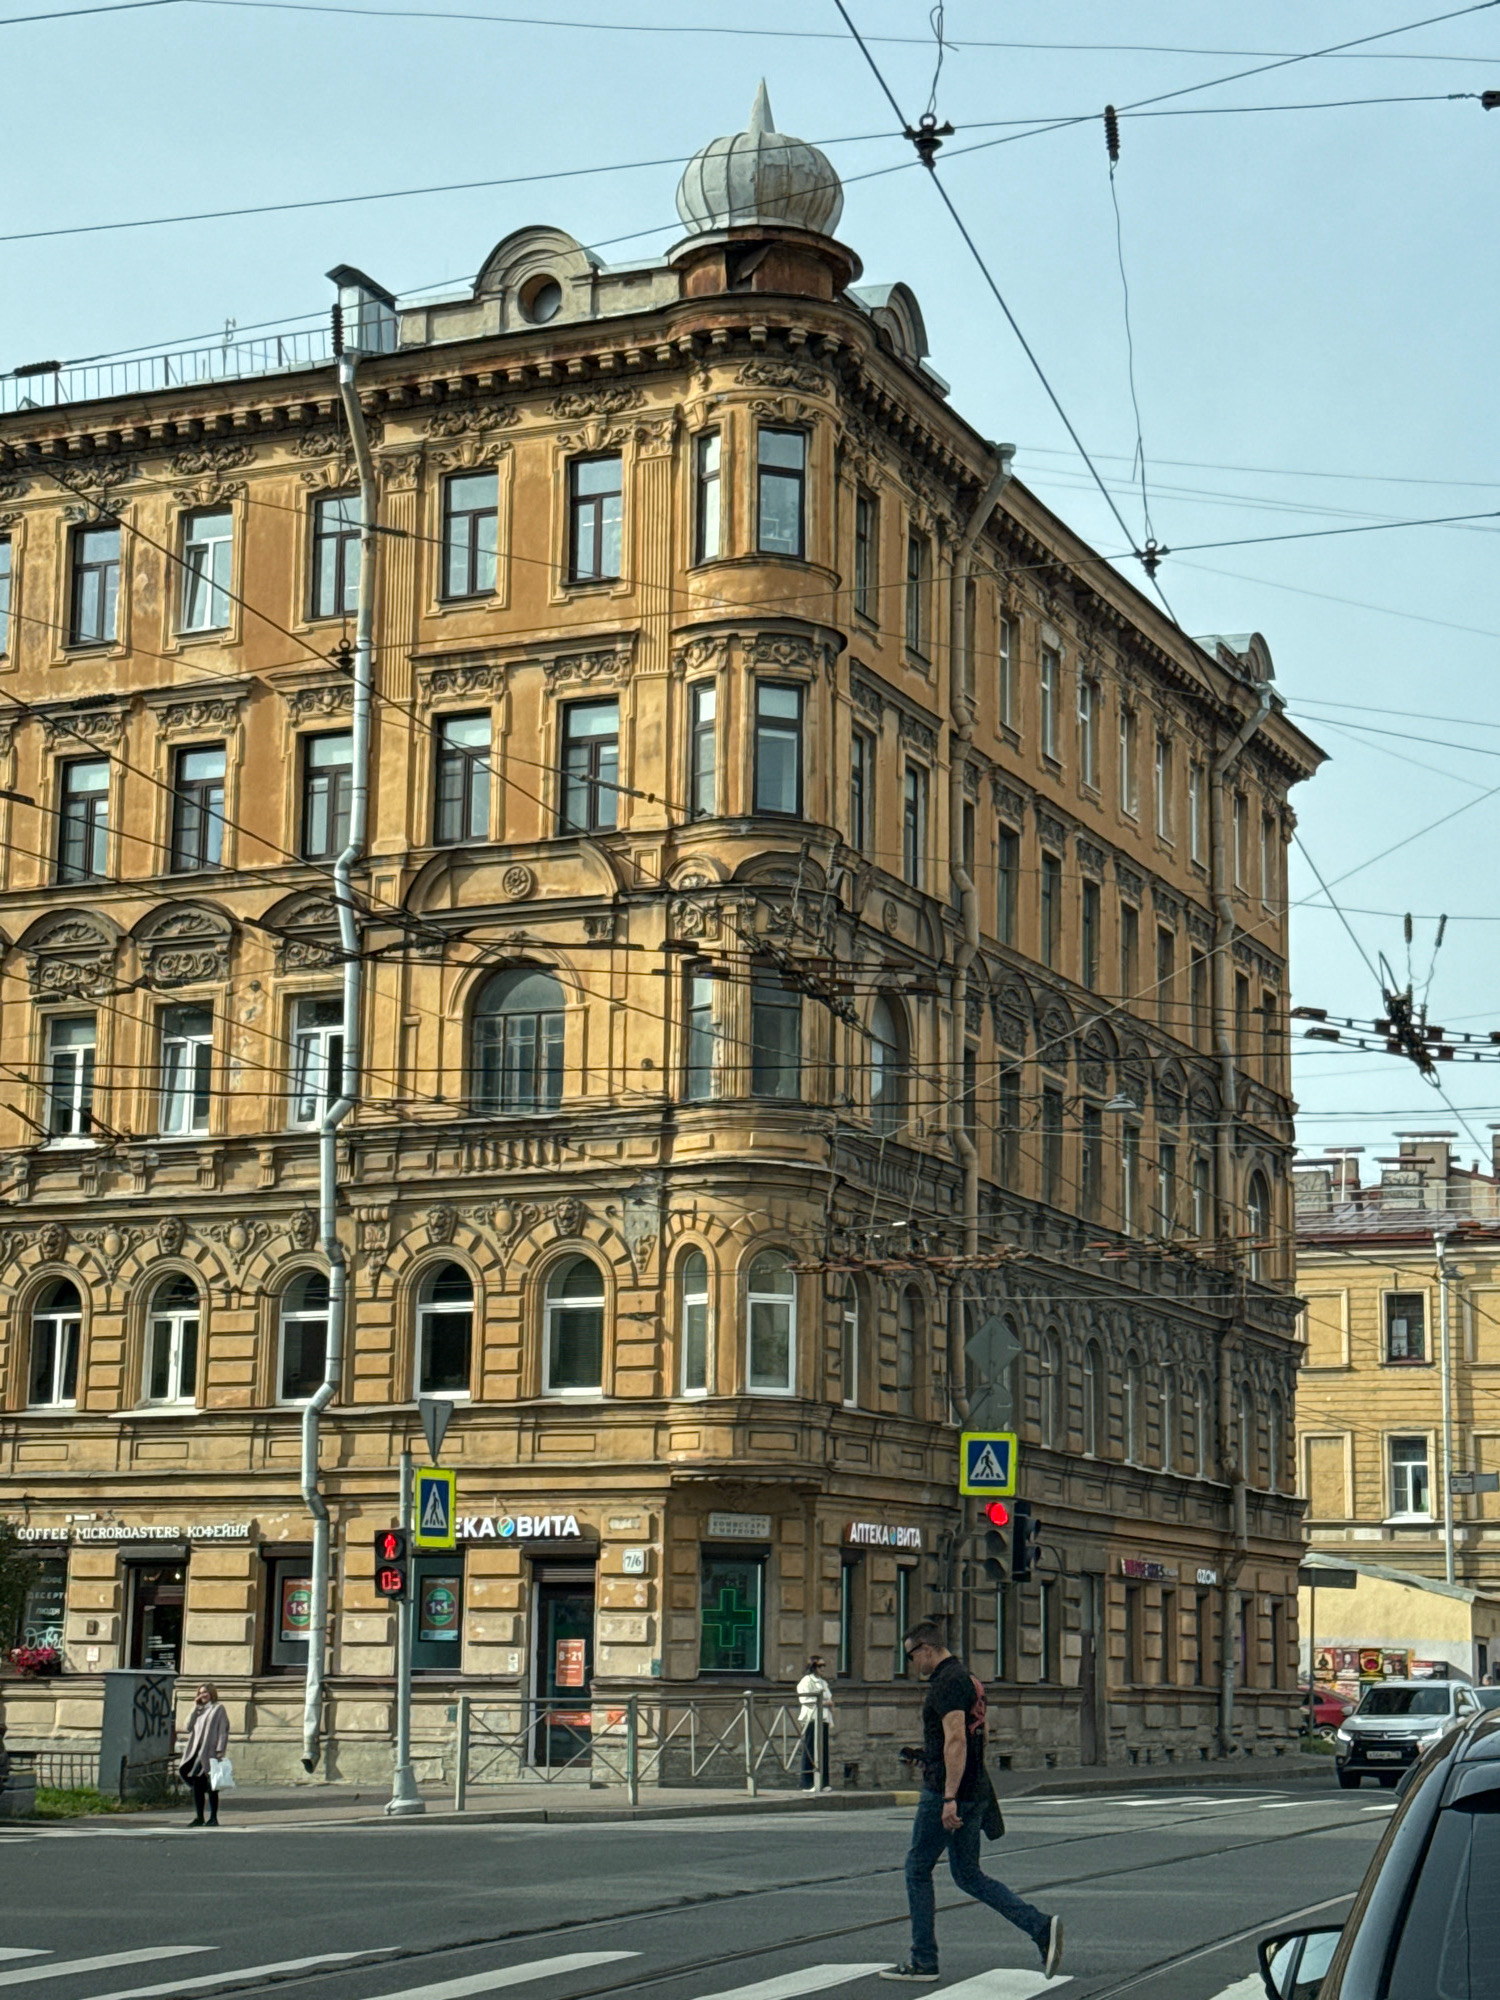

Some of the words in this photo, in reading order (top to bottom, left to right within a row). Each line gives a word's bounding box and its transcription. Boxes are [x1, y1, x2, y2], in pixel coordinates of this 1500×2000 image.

[17, 1527, 69, 1541] COFFEE
[75, 1526, 181, 1540] MICROROASTERS
[186, 1523, 251, 1538] КОФЕЙНЯ
[516, 1514, 581, 1537] ВИТА
[849, 1522, 890, 1546] АПТЕКА
[896, 1526, 922, 1549] ВИТА
[624, 1554, 642, 1568] 7/6
[381, 1570, 402, 1590] 03
[1196, 1568, 1217, 1585] OZON
